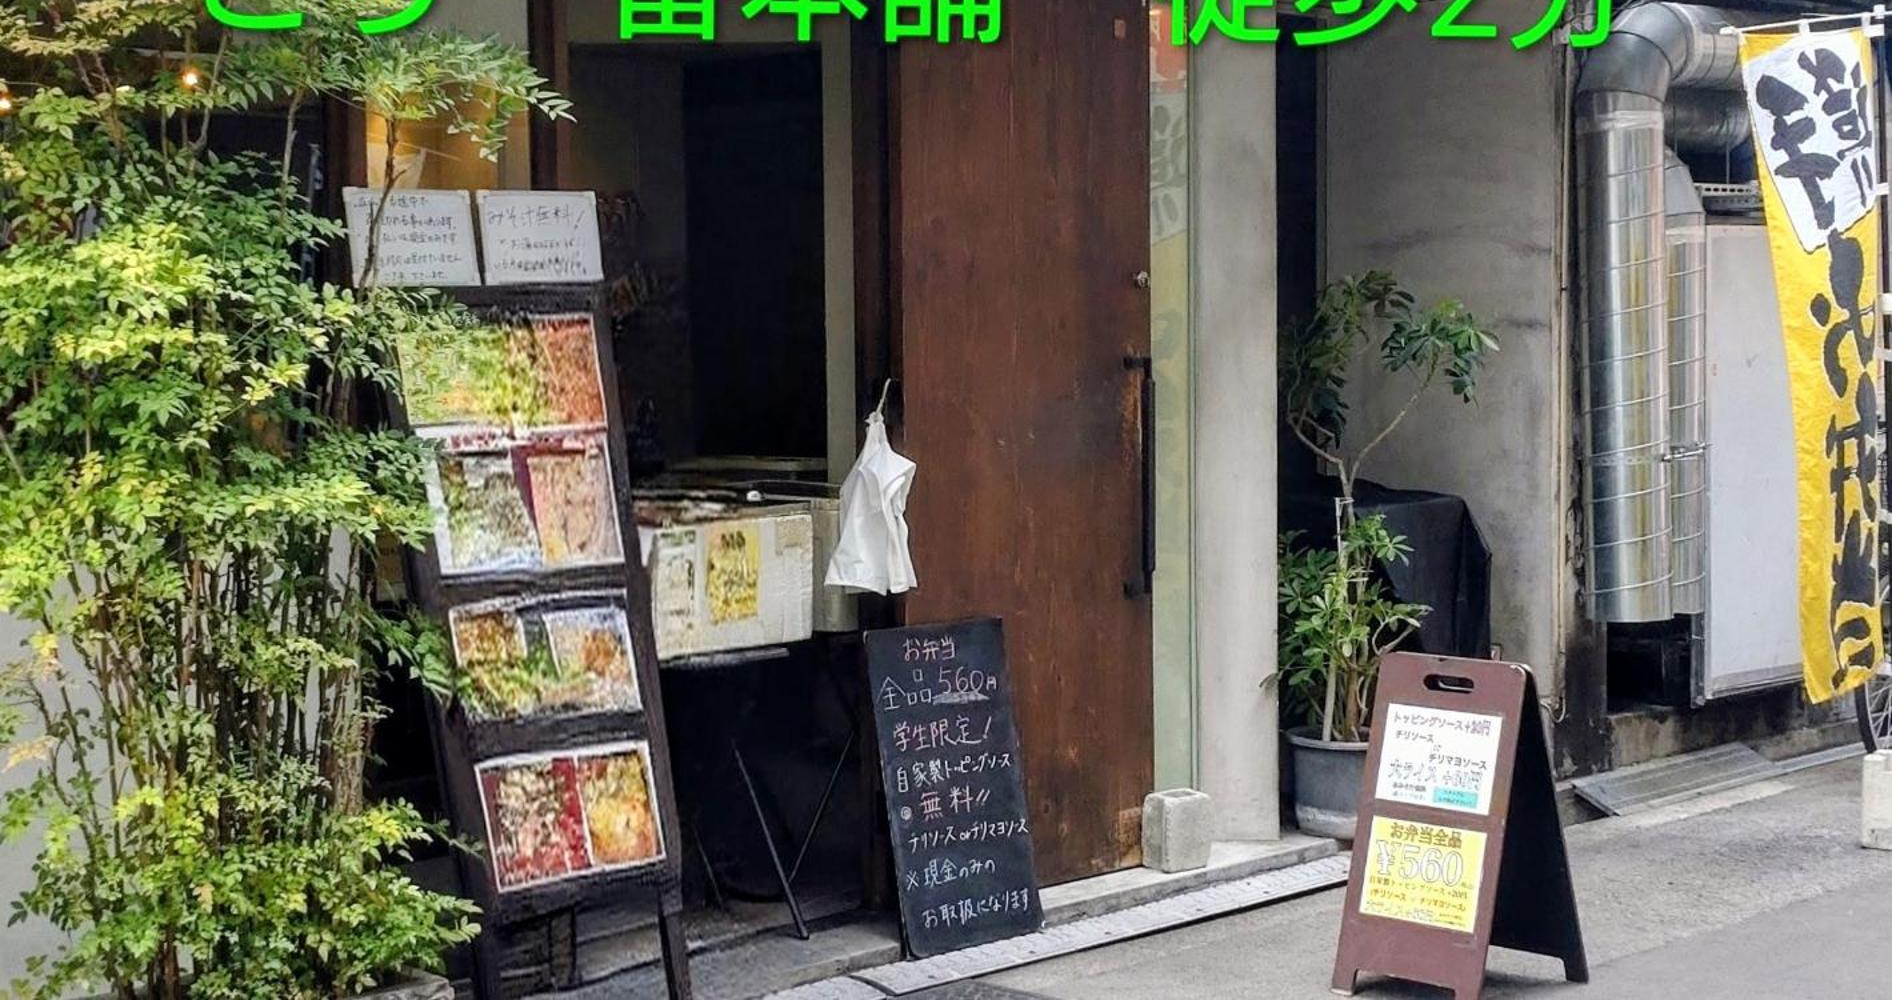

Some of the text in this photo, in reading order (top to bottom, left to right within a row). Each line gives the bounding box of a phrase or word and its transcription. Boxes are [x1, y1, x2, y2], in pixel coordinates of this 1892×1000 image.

[902, 635, 956, 662] お弁当
[1390, 822, 1463, 849] お弁当全品
[1375, 839, 1464, 887] ¥560
